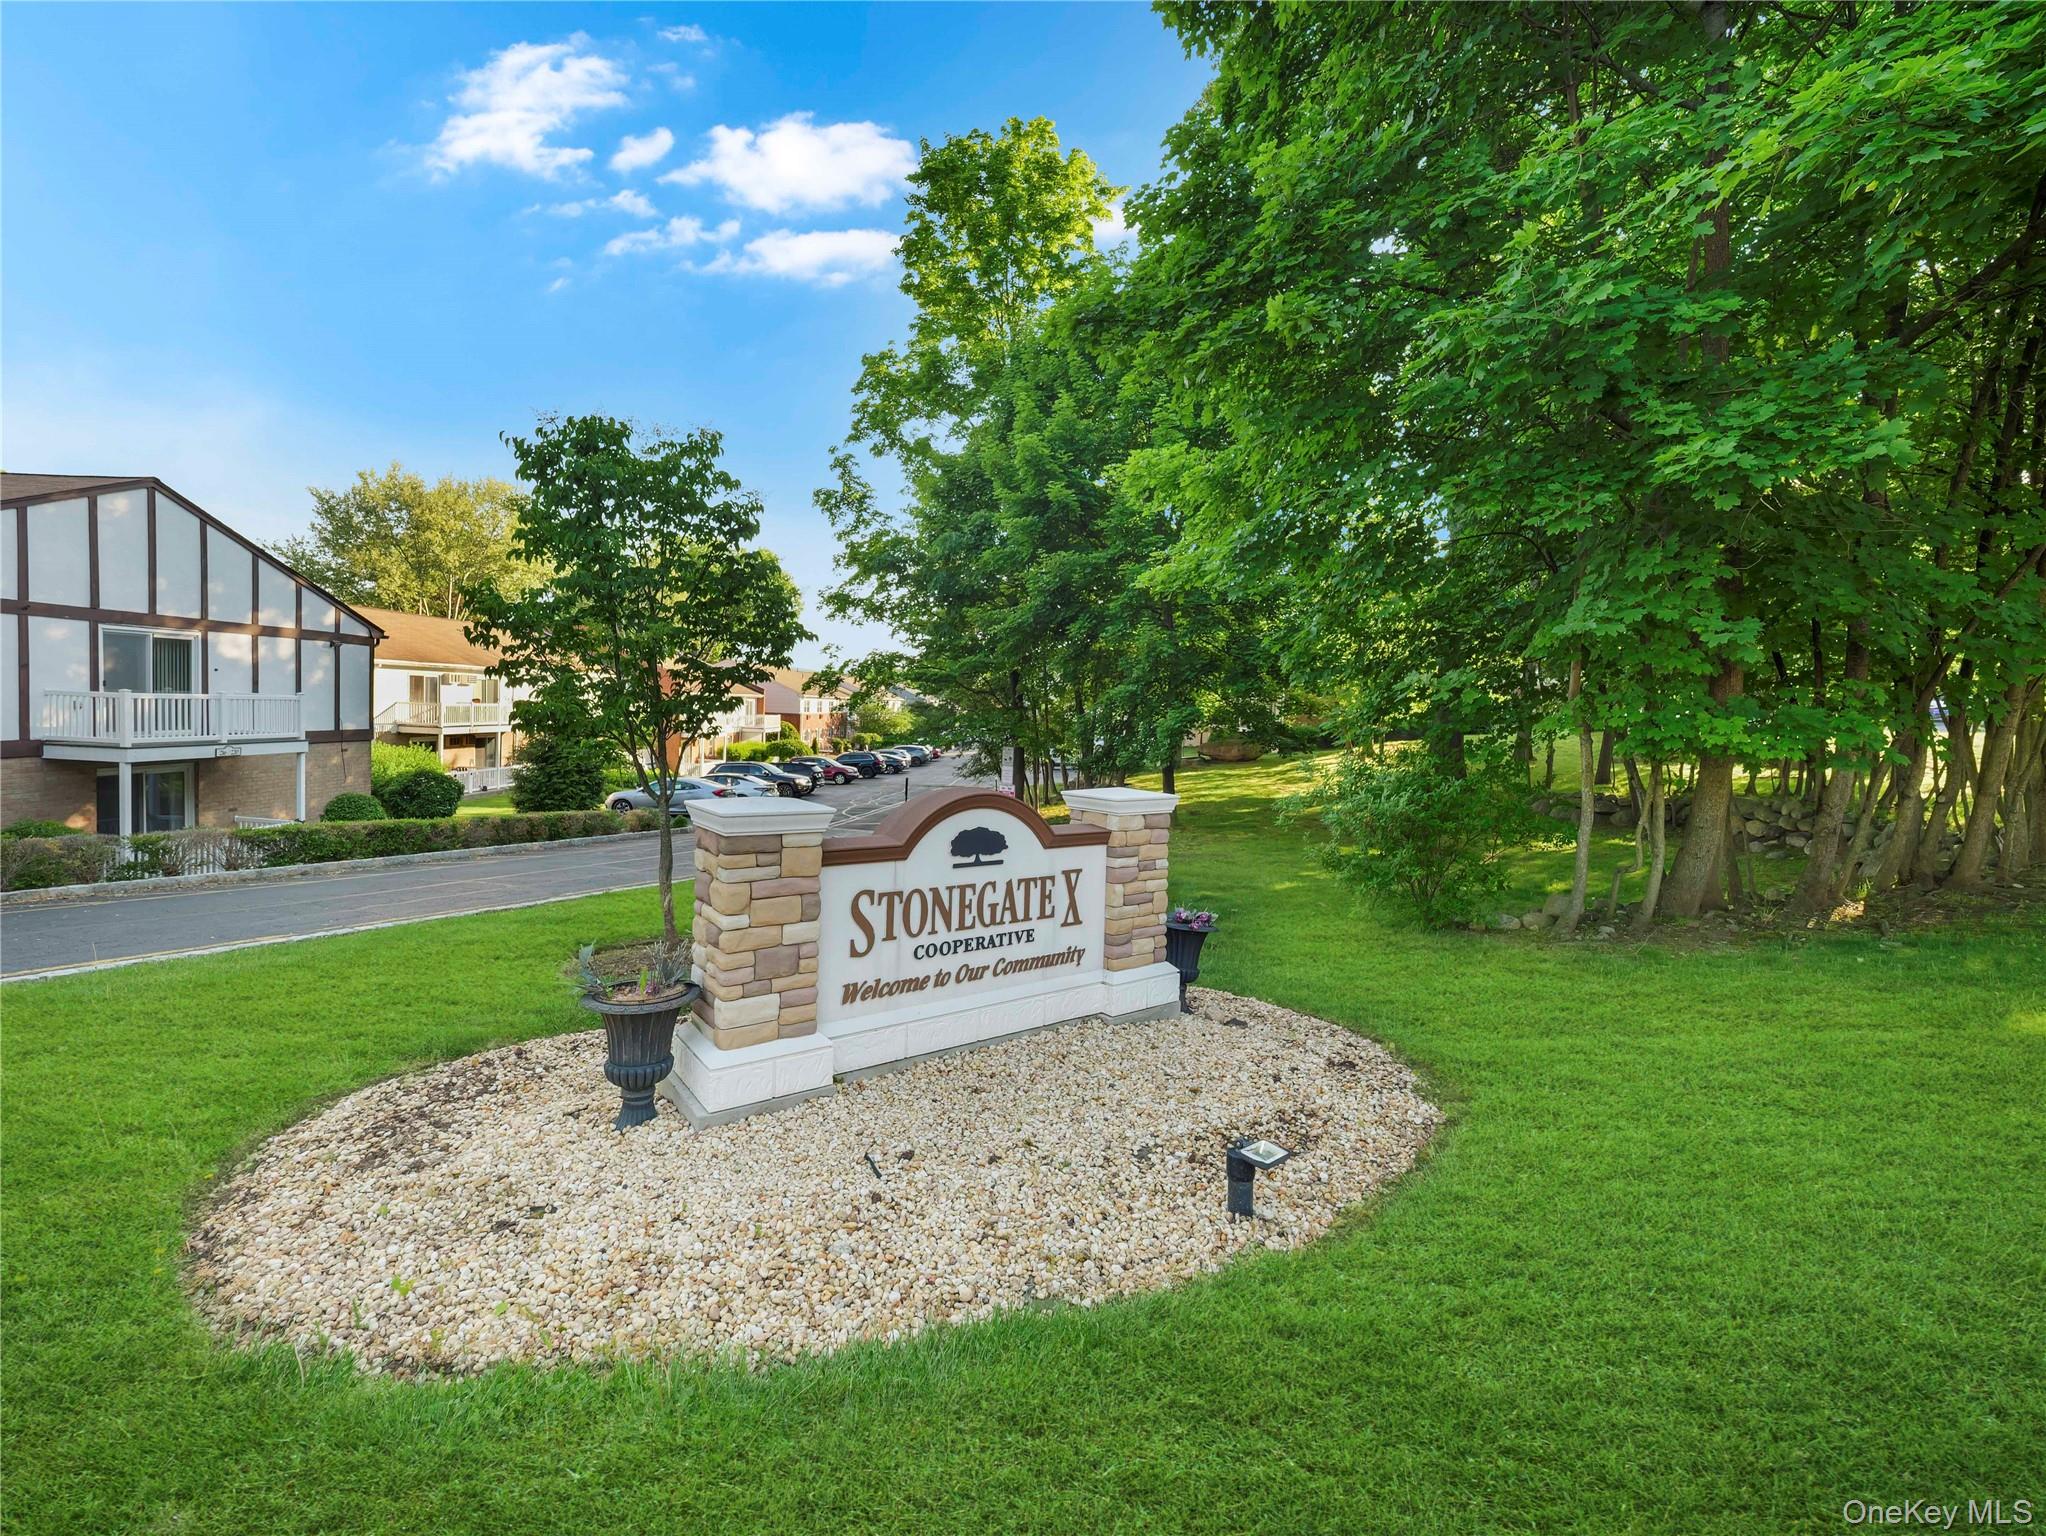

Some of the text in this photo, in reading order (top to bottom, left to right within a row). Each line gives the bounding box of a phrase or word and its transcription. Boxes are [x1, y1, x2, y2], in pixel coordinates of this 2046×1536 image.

[850, 868, 1083, 958] STONEGATE X
[913, 928, 1035, 960] COOPERATIVE
[841, 945, 1086, 1005] Welcome to Our Community
